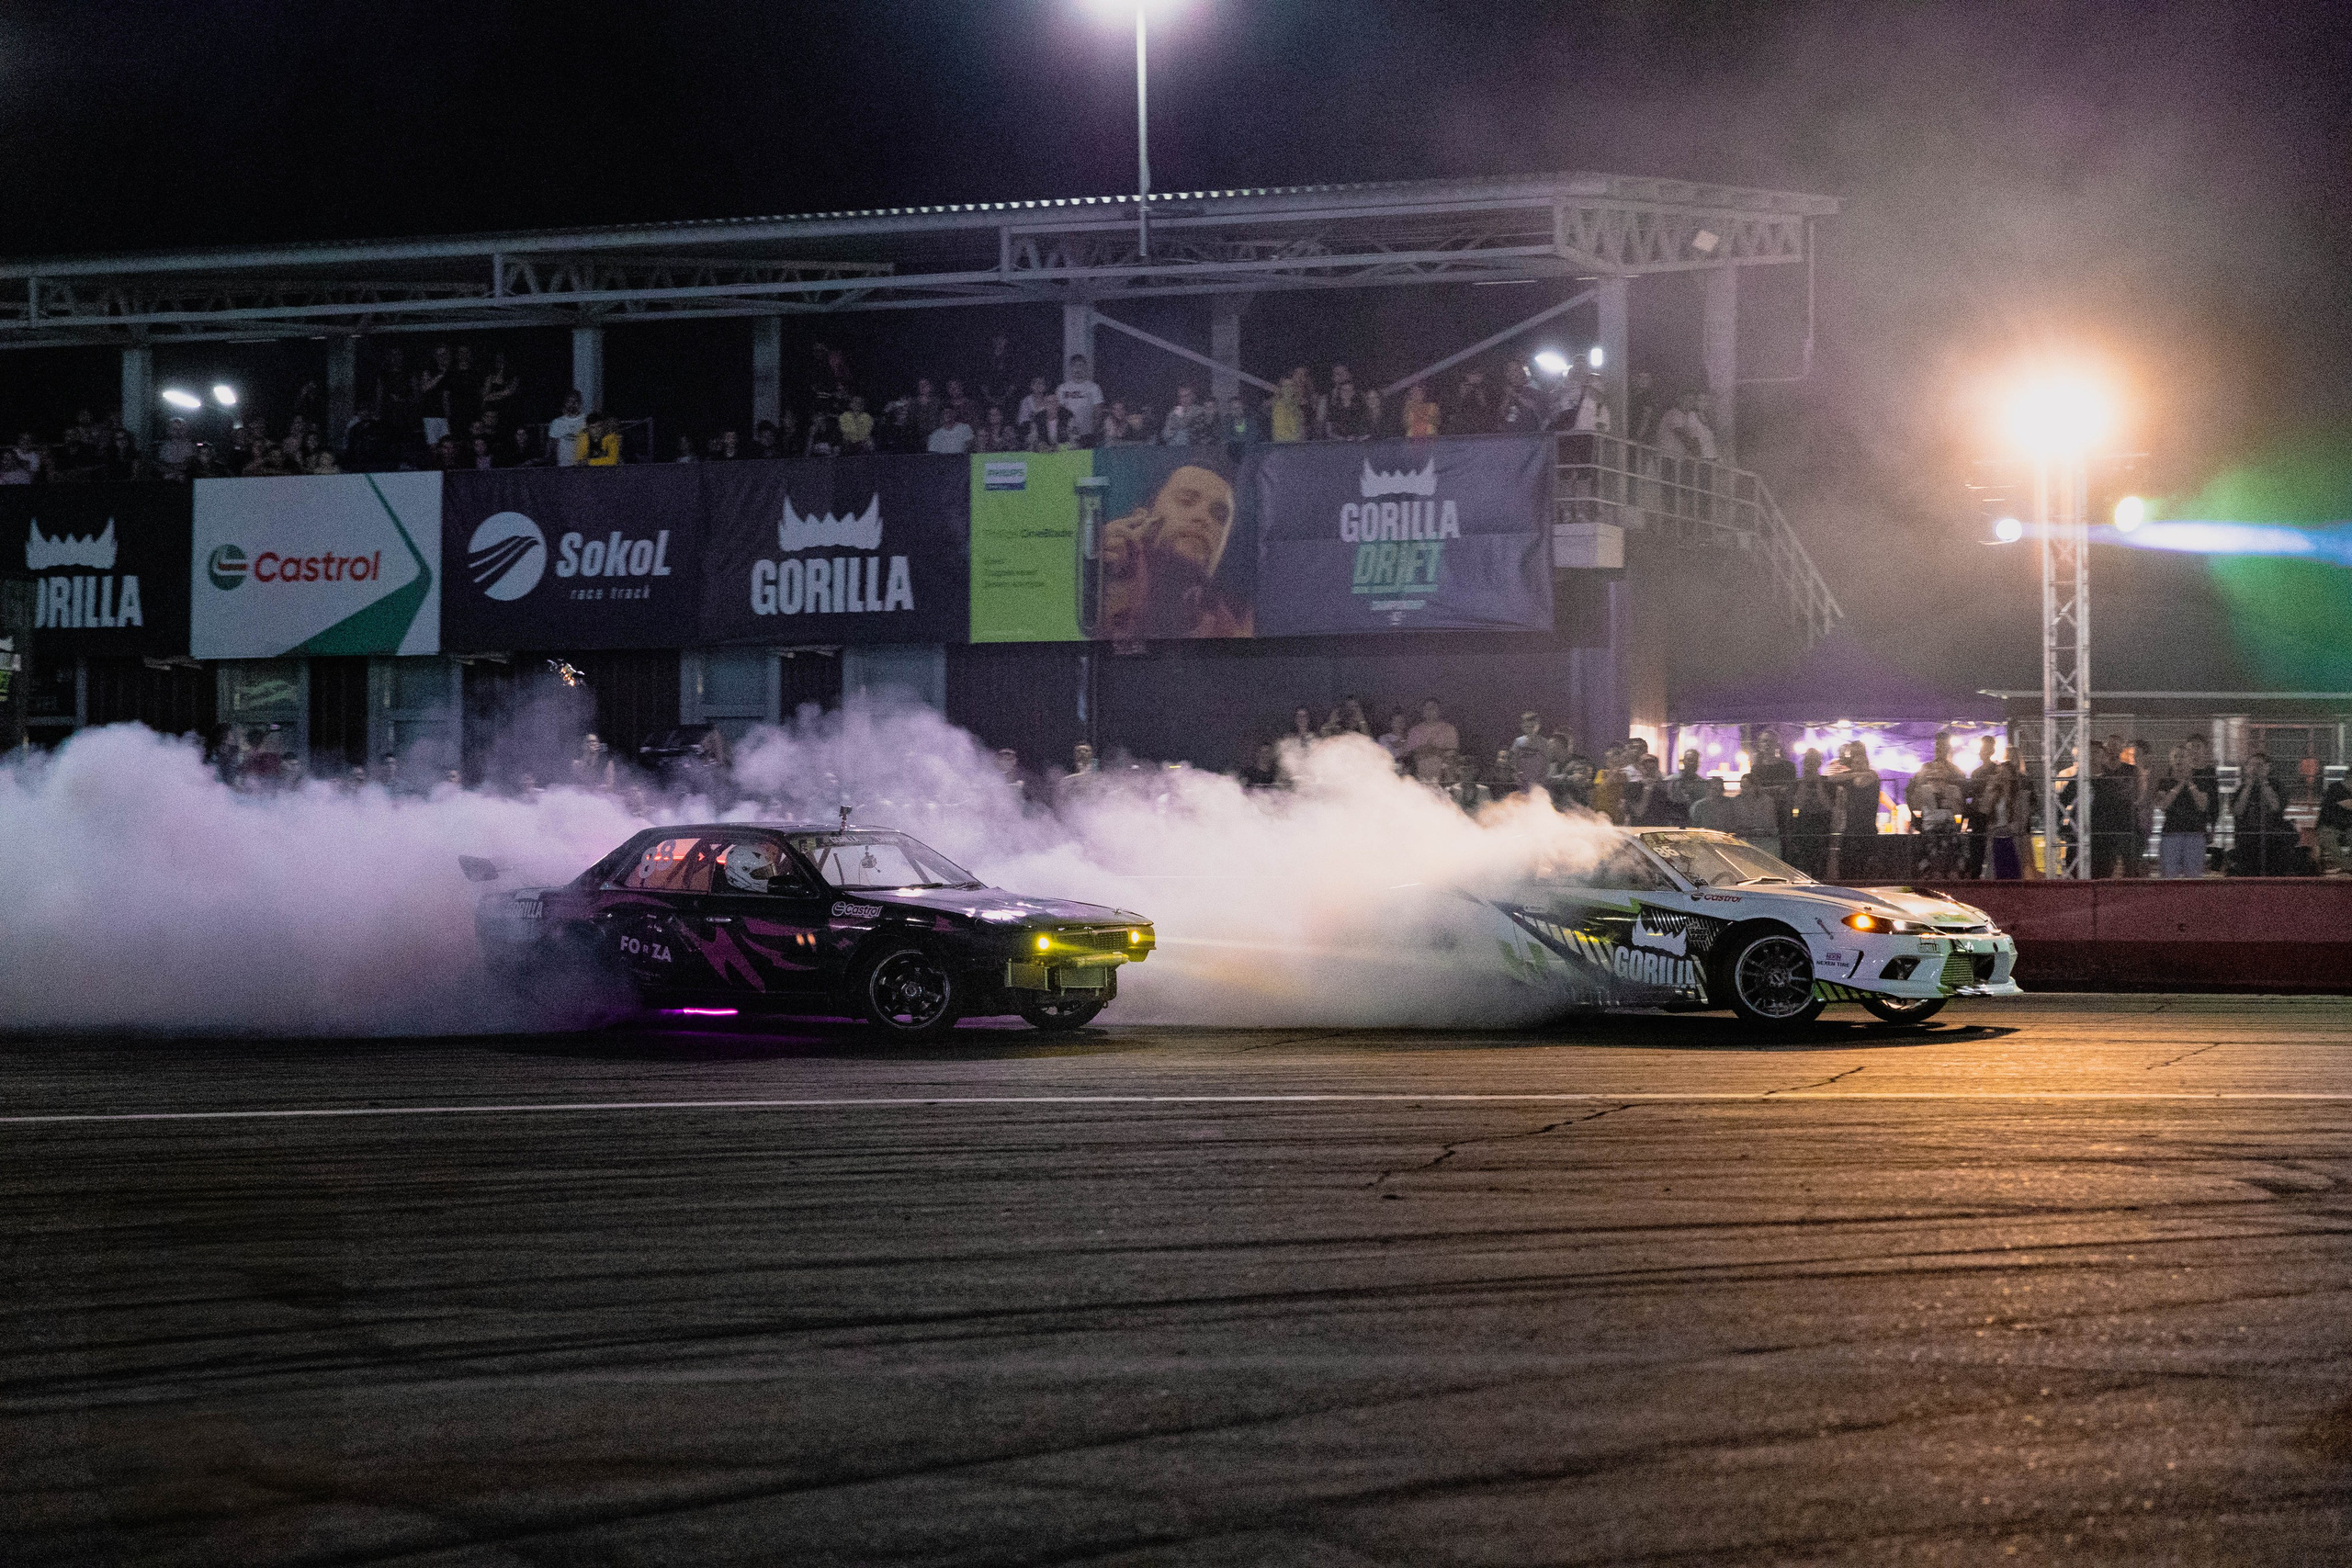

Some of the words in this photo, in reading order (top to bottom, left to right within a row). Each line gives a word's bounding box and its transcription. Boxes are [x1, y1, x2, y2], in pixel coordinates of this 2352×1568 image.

[1340, 500, 1461, 543] GORILLA
[254, 550, 380, 582] Castrol
[1352, 540, 1445, 584] DRIFT
[34, 574, 144, 628] RILLA
[569, 589, 604, 600] race
[750, 555, 915, 615] GORILLA
[639, 840, 676, 878] 88
[1652, 845, 1679, 858] 86
[844, 904, 884, 918] Castrol
[1703, 894, 1743, 903] Castrol
[1613, 945, 1697, 989] GORILLA
